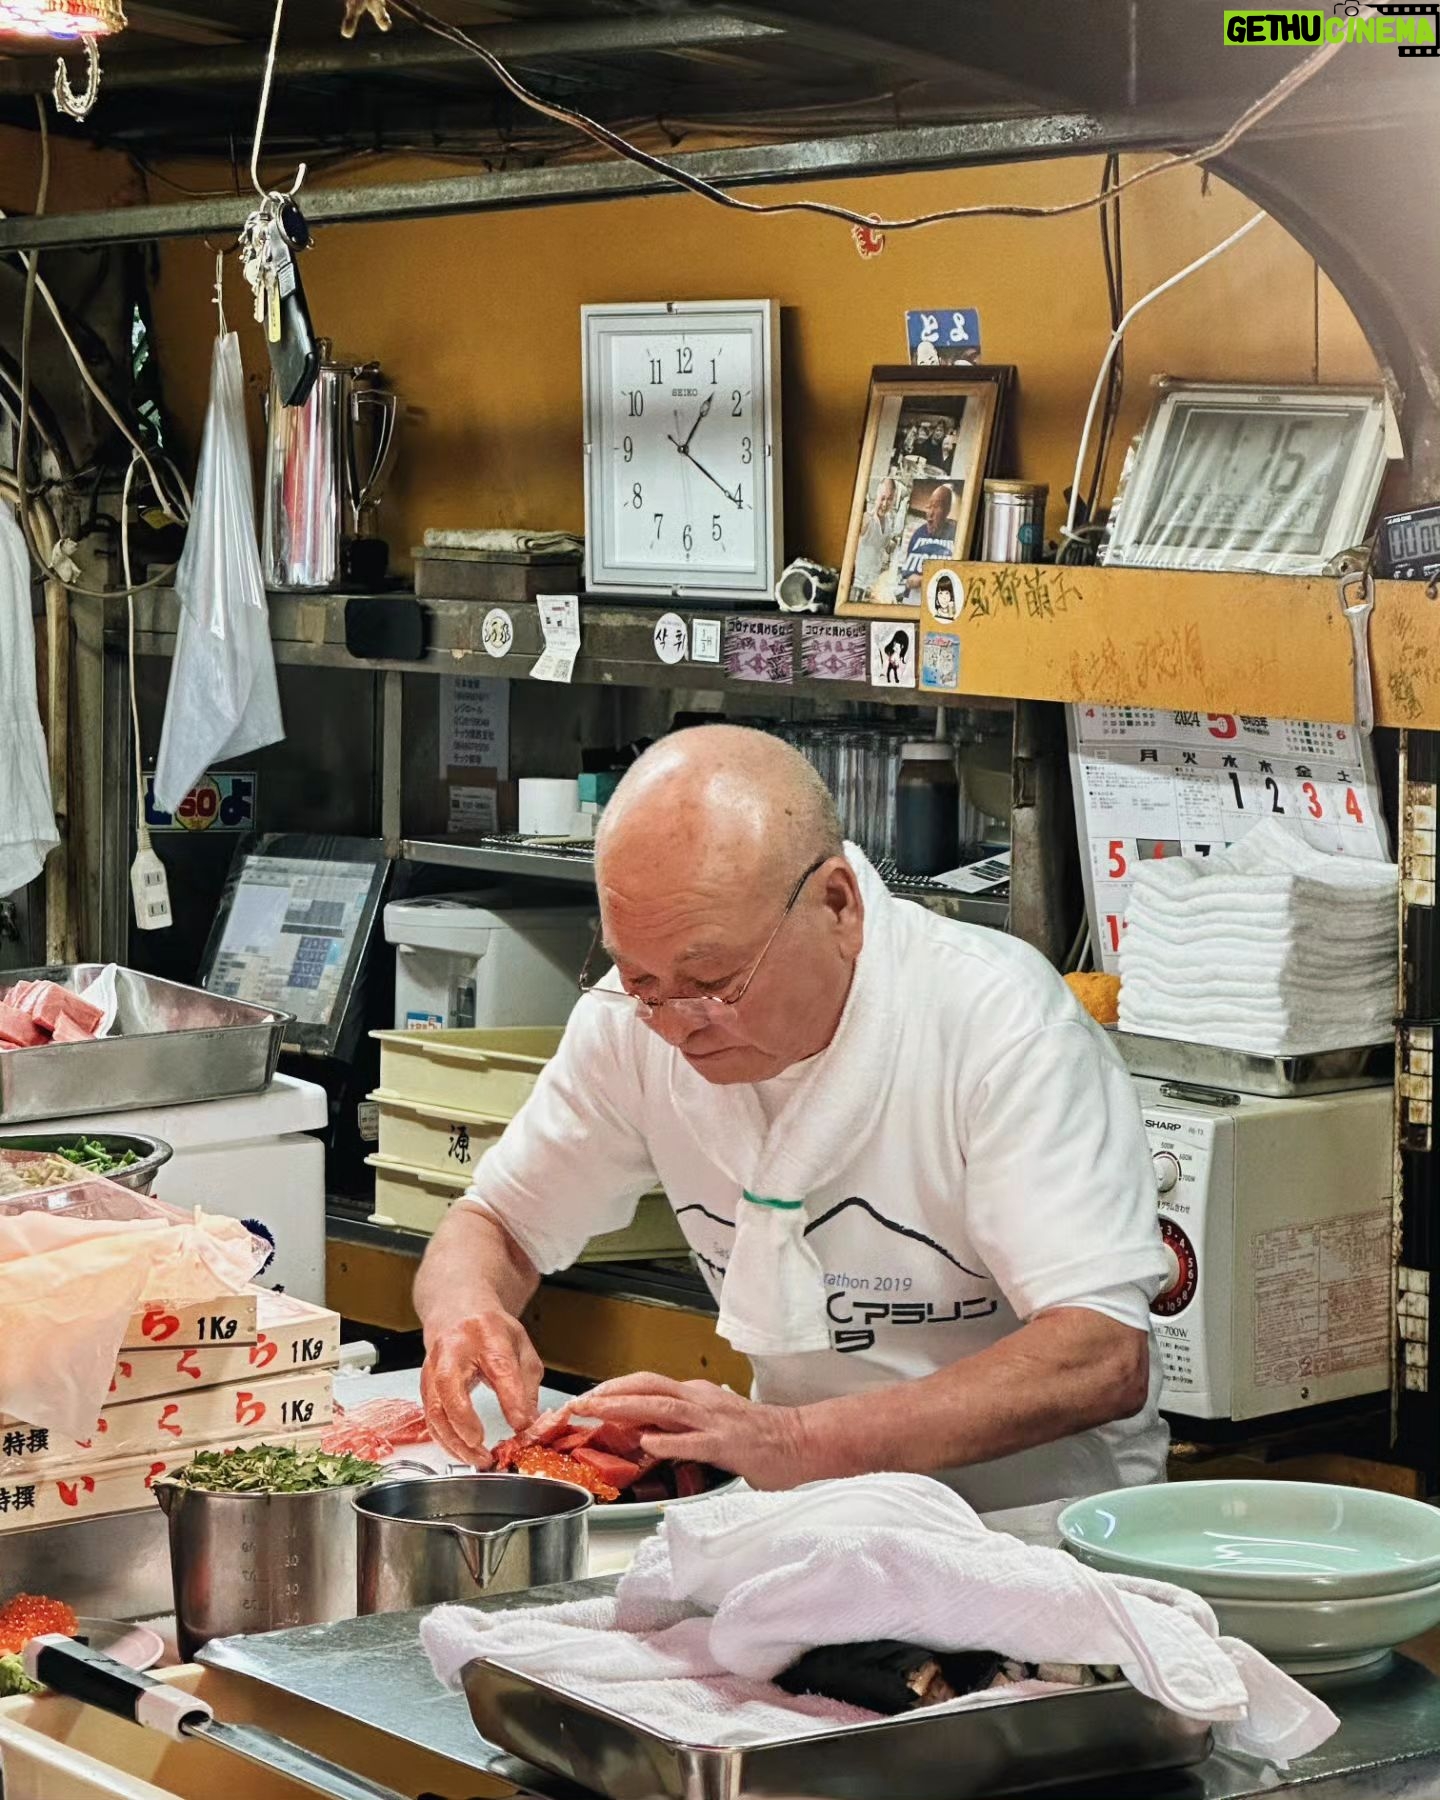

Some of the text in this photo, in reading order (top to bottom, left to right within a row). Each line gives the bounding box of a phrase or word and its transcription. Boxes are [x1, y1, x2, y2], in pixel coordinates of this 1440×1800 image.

[650, 359, 663, 384] 11
[676, 347, 693, 374] 12
[710, 359, 716, 384] 1
[628, 390, 644, 417] 10
[672, 389, 698, 397] SEIKO
[732, 390, 743, 417] 2
[624, 436, 633, 462] 9
[742, 437, 751, 464] 3
[632, 483, 643, 509] 8
[733, 484, 744, 509] 4
[654, 514, 664, 540] 7
[683, 525, 693, 551] 6
[712, 515, 722, 541] 5
[1086, 709, 1095, 718] 4
[1336, 730, 1347, 740] 6
[1140, 749, 1352, 784] 月 火 水 木 金 土
[1229, 772, 1244, 809] 1
[1265, 777, 1285, 815] 2
[1302, 782, 1323, 820] 3
[1345, 787, 1363, 824] 4
[1108, 840, 1127, 878] 5
[1144, 1119, 1182, 1131] SHARP
[873, 1277, 912, 1291] 2019
[197, 1316, 238, 1340] 1Kg
[1164, 1326, 1188, 1337] 700W
[291, 1338, 323, 1363] 1Kg
[3, 1428, 49, 1456] 特撰
[281, 1400, 314, 1424] 1Kg
